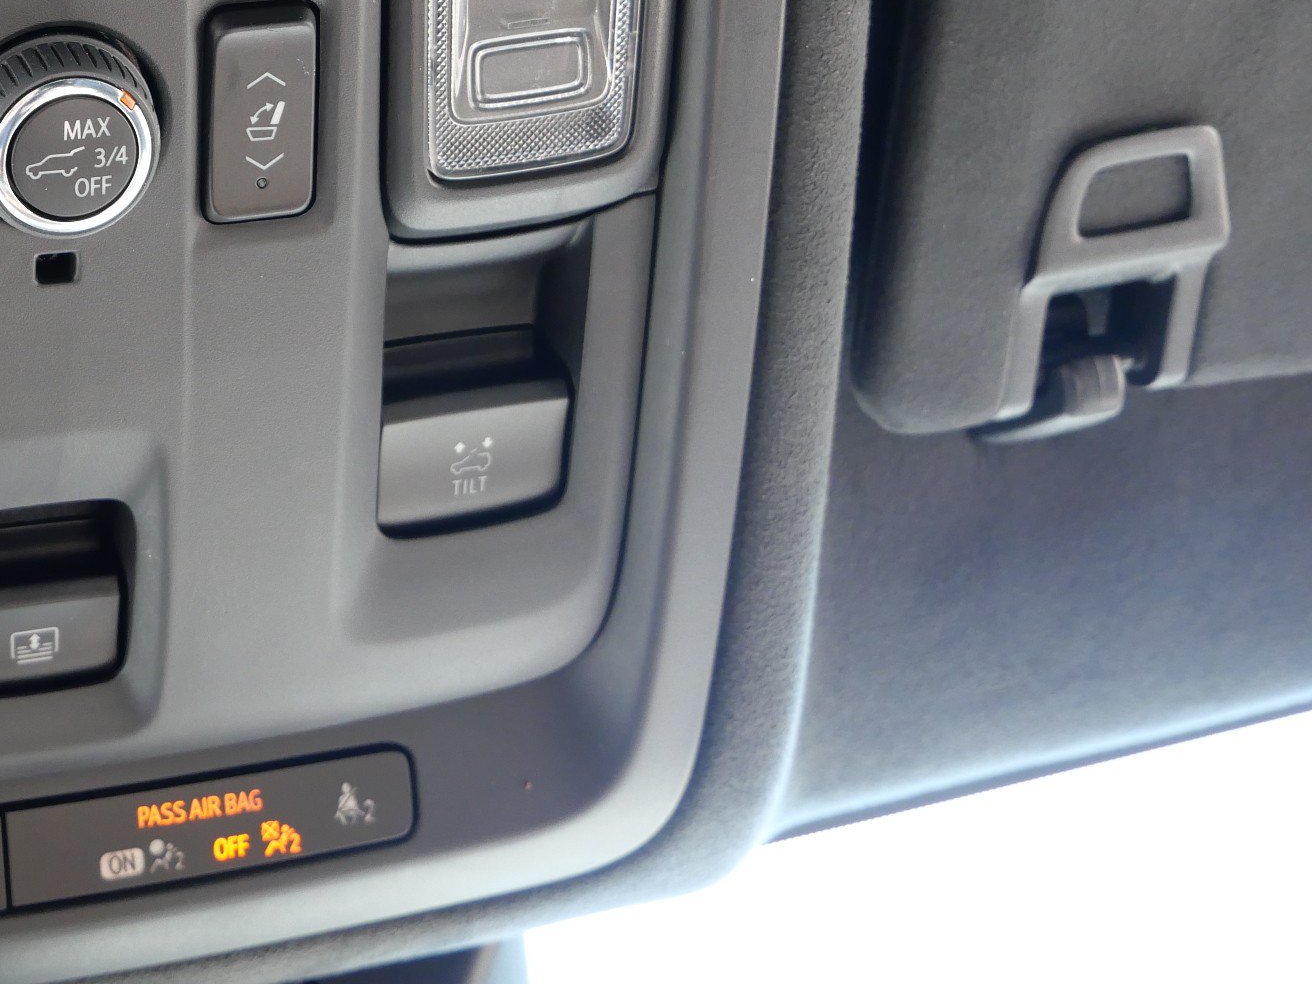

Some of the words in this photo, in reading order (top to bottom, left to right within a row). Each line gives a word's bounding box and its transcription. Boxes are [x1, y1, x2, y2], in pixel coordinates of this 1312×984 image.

[63, 117, 111, 141] MAX
[94, 147, 129, 168] 3/4
[74, 177, 113, 197] OFF
[453, 475, 488, 496] TILT
[137, 800, 186, 829] PASS
[189, 796, 222, 820] AIR
[224, 788, 263, 814] BAG
[213, 833, 250, 862] OFF
[109, 852, 137, 875] ON
